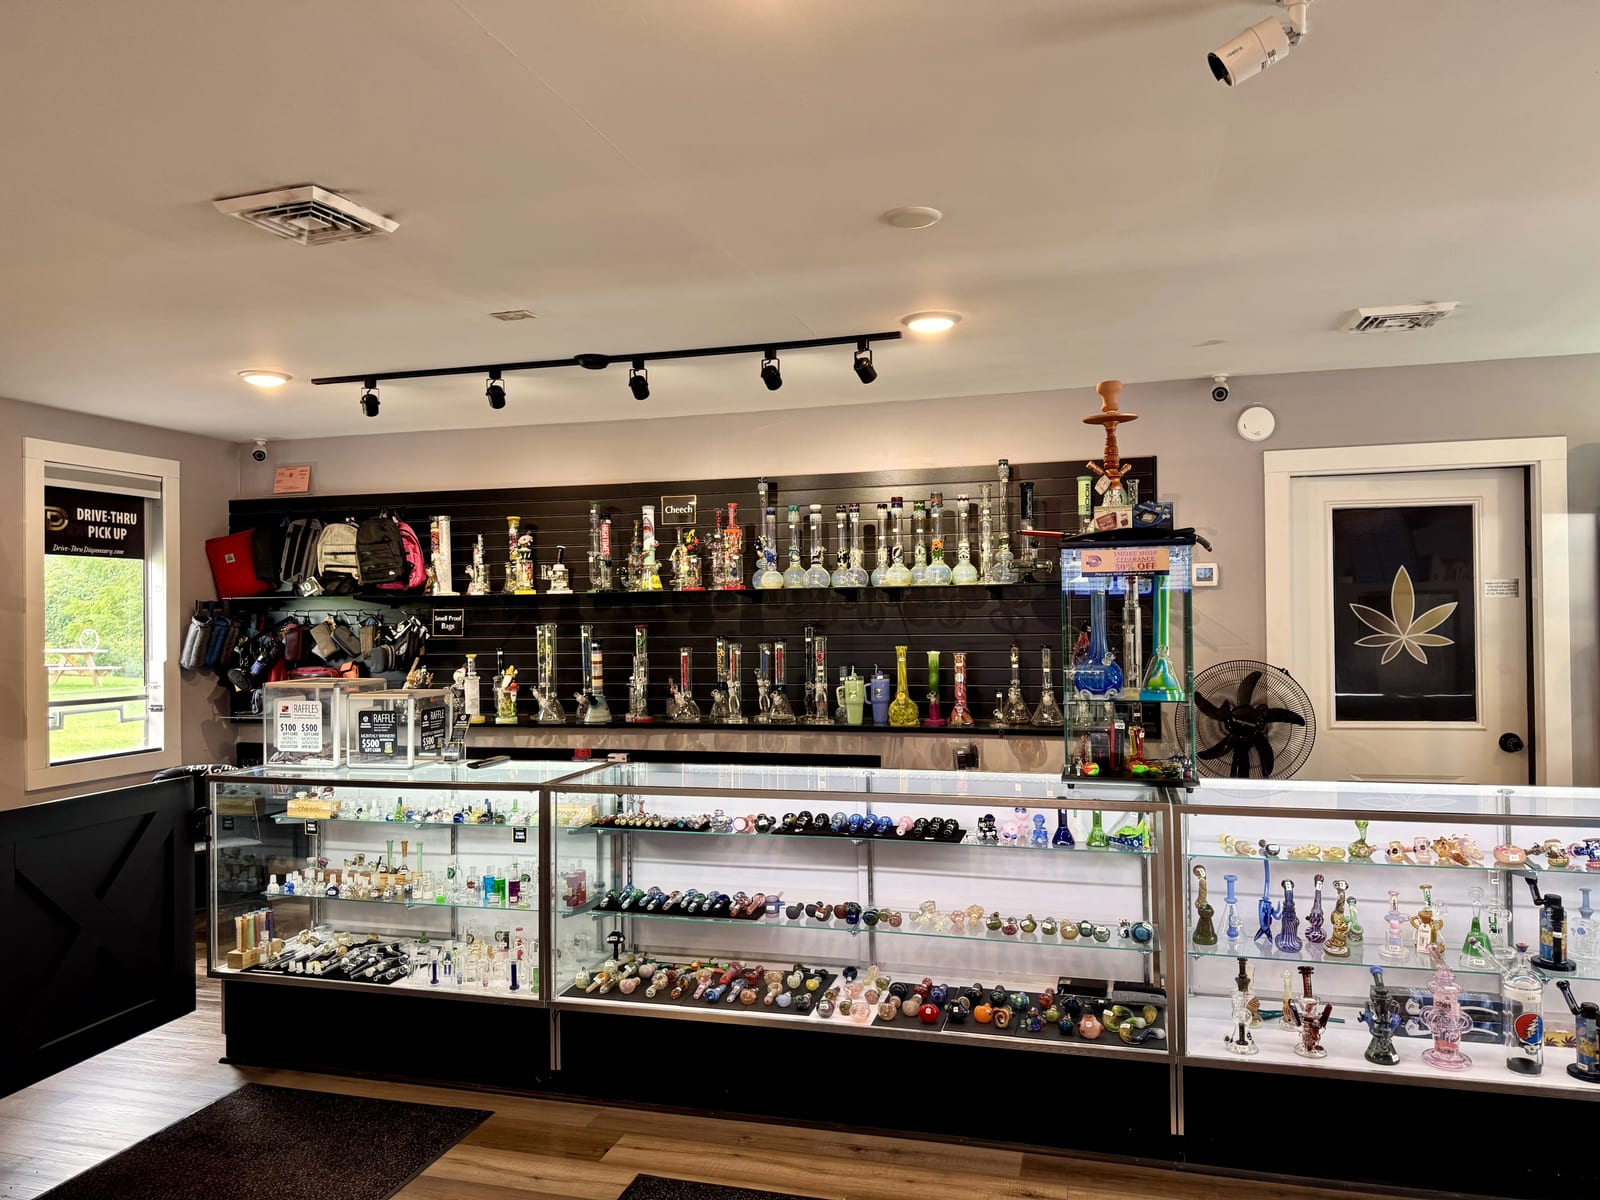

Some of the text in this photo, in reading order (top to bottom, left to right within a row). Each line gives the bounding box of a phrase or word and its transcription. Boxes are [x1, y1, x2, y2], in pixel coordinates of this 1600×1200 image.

[665, 505, 693, 514] Cheech
[77, 507, 137, 525] DRIVE-THRU
[88, 526, 127, 540] PICK UP
[1137, 562, 1157, 570] OFF
[441, 623, 455, 631] Bags
[293, 704, 319, 713] RAFFLES
[373, 713, 395, 723] RAFFLE
[280, 723, 318, 732] $100 $500
[362, 738, 380, 748] $500
[423, 736, 435, 747] $500
